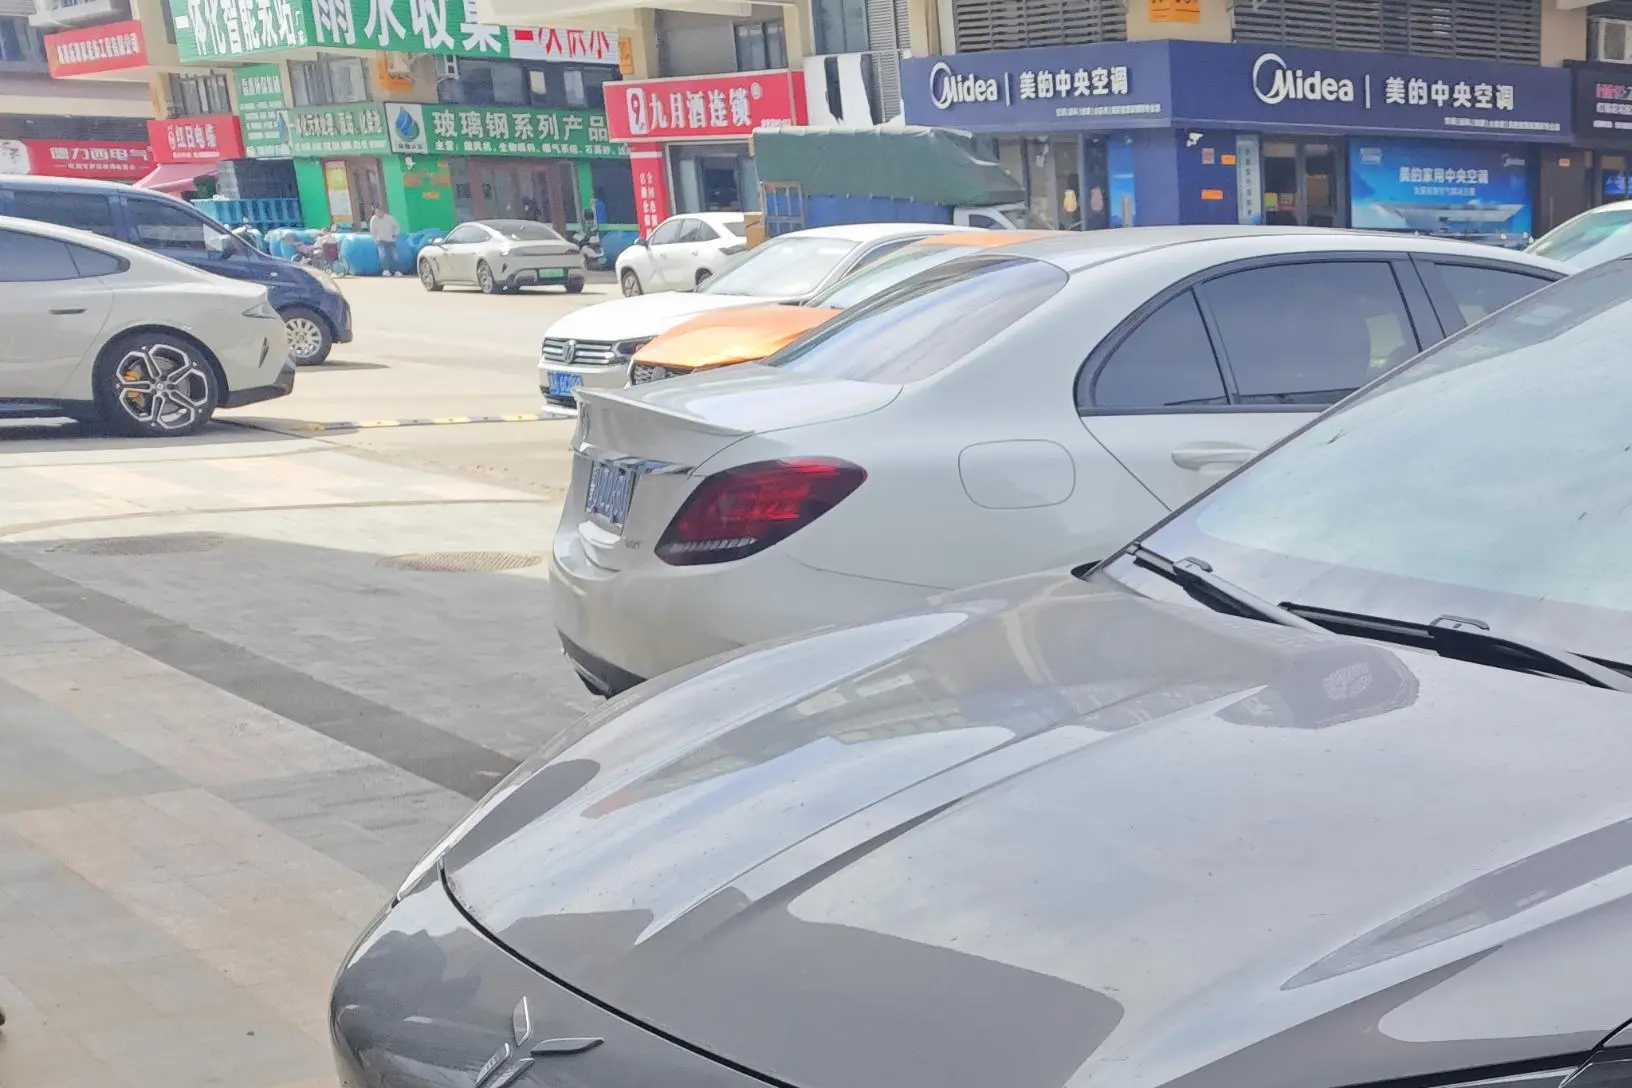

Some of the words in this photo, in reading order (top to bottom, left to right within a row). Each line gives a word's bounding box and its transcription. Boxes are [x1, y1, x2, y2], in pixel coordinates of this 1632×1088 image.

[930, 62, 998, 110] Midea
[1020, 66, 1128, 99] 美的中央空调
[1253, 53, 1354, 104] Midea
[1385, 77, 1514, 111] 美的中央空调
[432, 110, 608, 142] 玻璃钢系列产品
